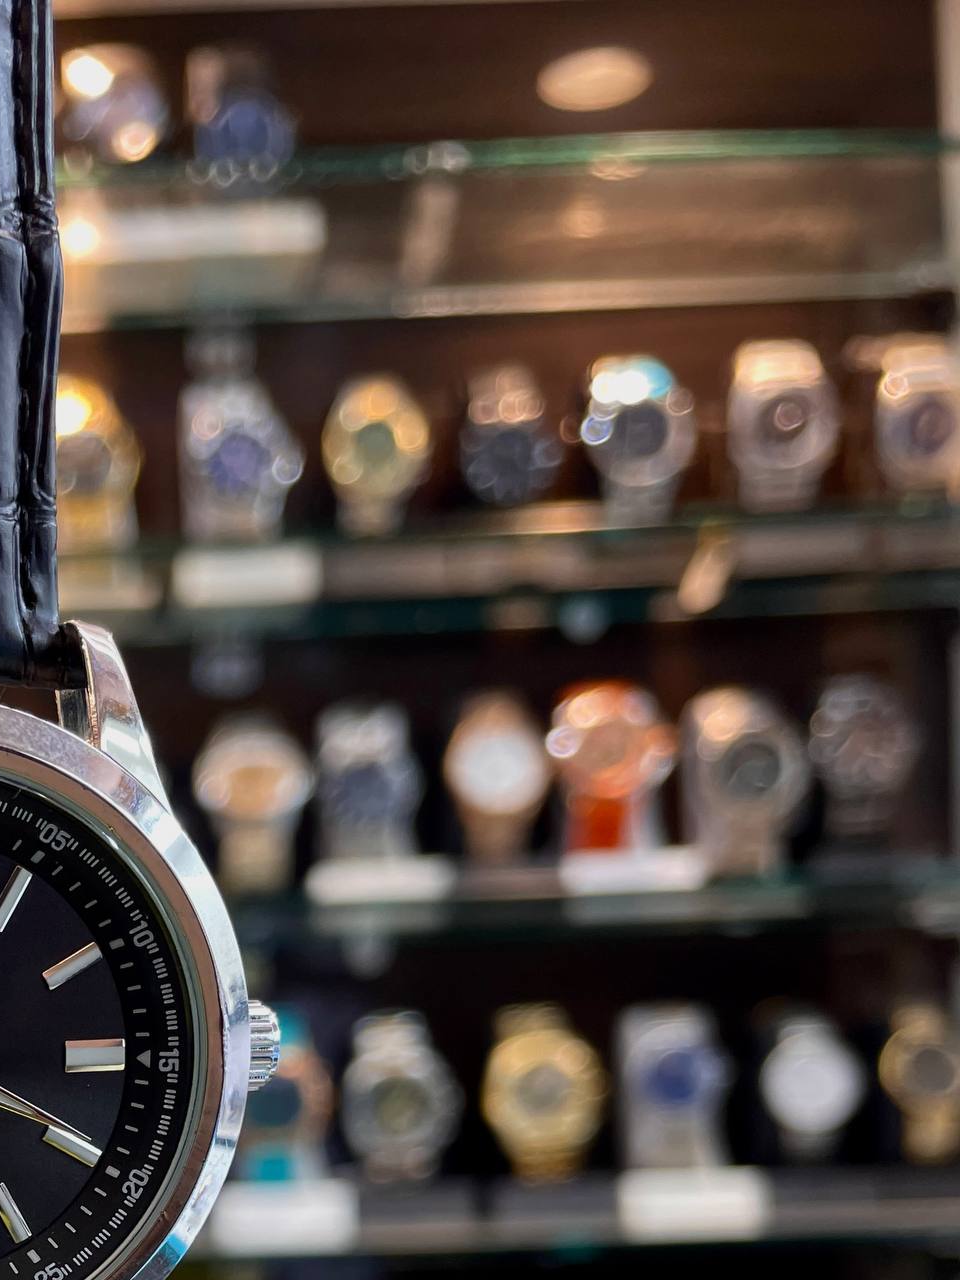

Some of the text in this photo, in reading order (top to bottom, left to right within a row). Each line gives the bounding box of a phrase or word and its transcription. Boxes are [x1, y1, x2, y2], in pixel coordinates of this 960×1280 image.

[40, 823, 71, 851] 05
[129, 921, 152, 947] 10
[159, 1048, 179, 1072] 15
[121, 1169, 149, 1196] 20
